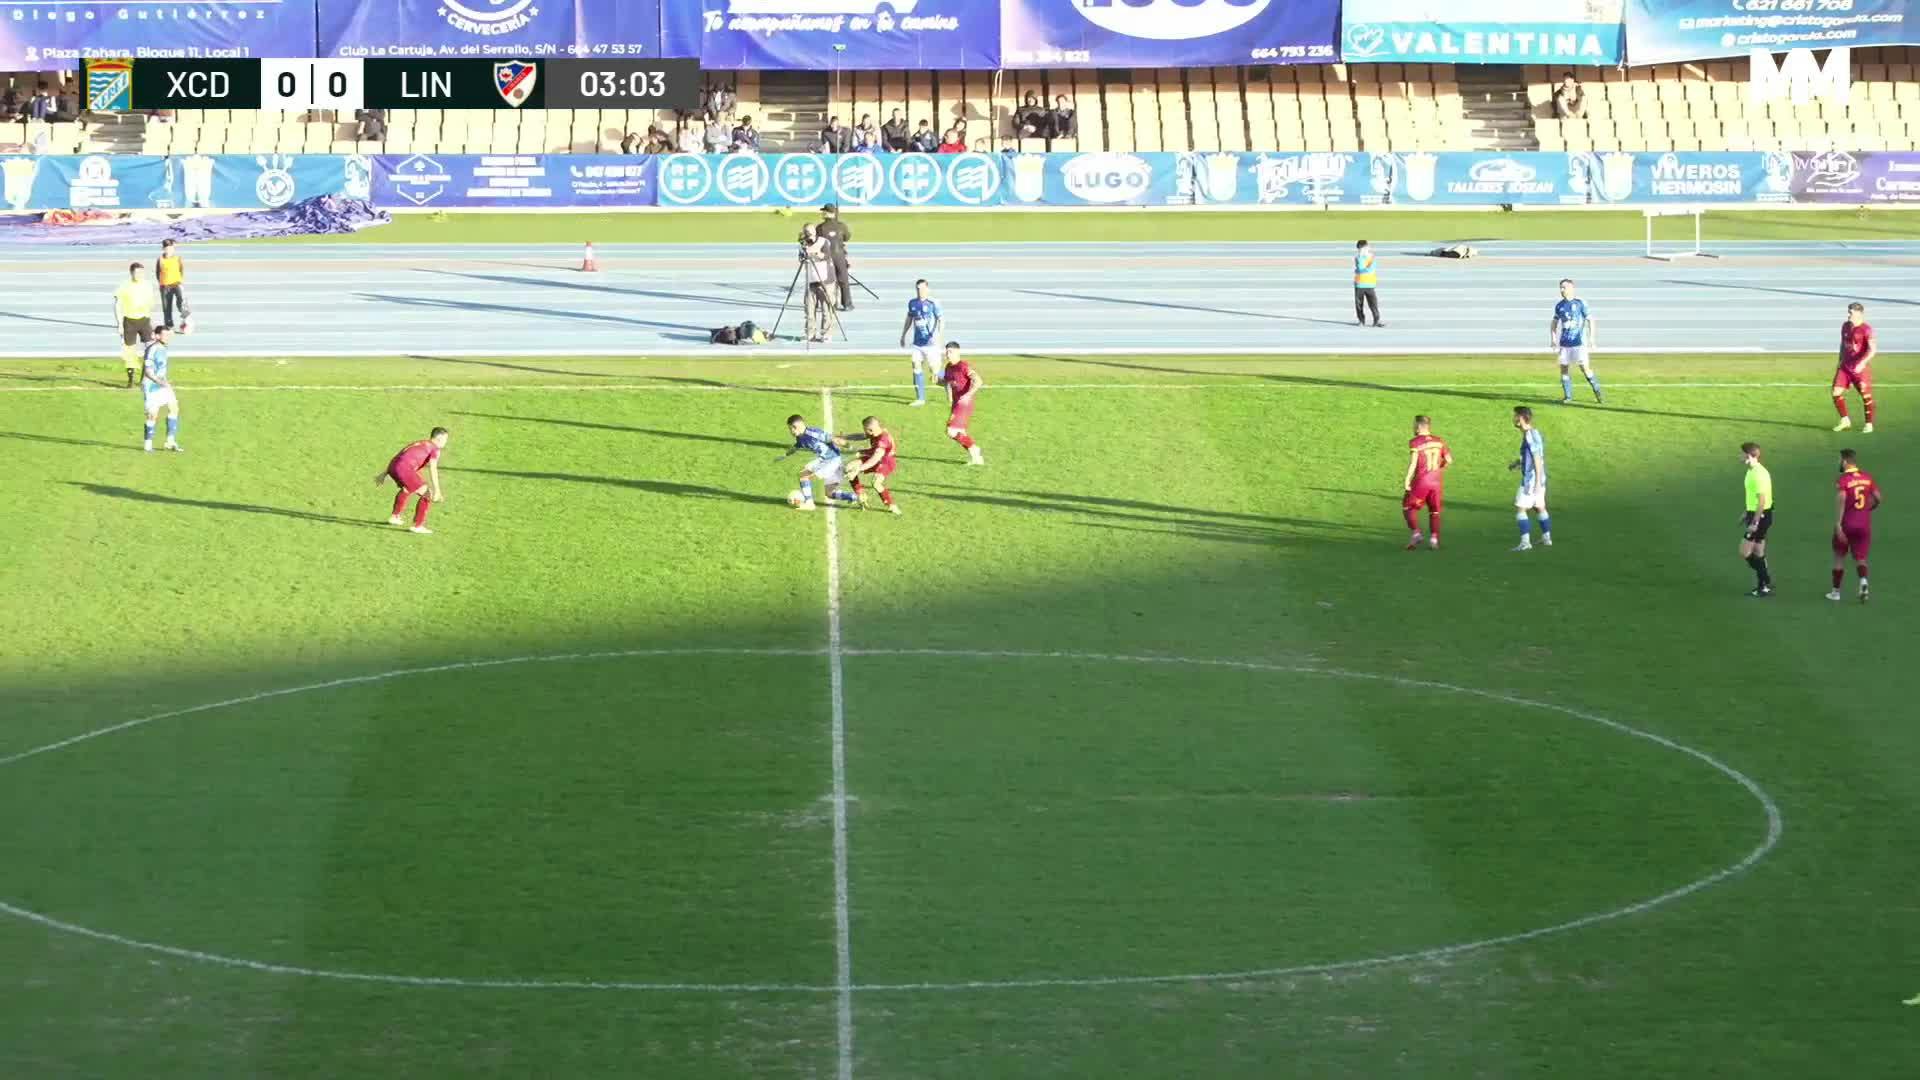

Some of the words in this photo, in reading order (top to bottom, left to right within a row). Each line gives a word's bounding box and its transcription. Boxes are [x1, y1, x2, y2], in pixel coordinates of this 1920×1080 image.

[340, 47, 369, 56] Club
[372, 46, 385, 55] La
[389, 45, 437, 57] Cartuja,
[439, 45, 458, 55] Av.
[461, 44, 480, 54] del
[481, 43, 533, 56] Serrallo,
[535, 43, 557, 55] S/N
[593, 43, 609, 54] 47
[610, 43, 626, 54] 53
[628, 43, 643, 54] 57
[1391, 31, 1603, 56] VALENTINA
[43, 48, 79, 58] Plaza
[205, 47, 242, 58] Local
[1650, 164, 1741, 180] VIVEROS
[1071, 172, 1144, 189] LUGO
[1854, 486, 1866, 510] 5
